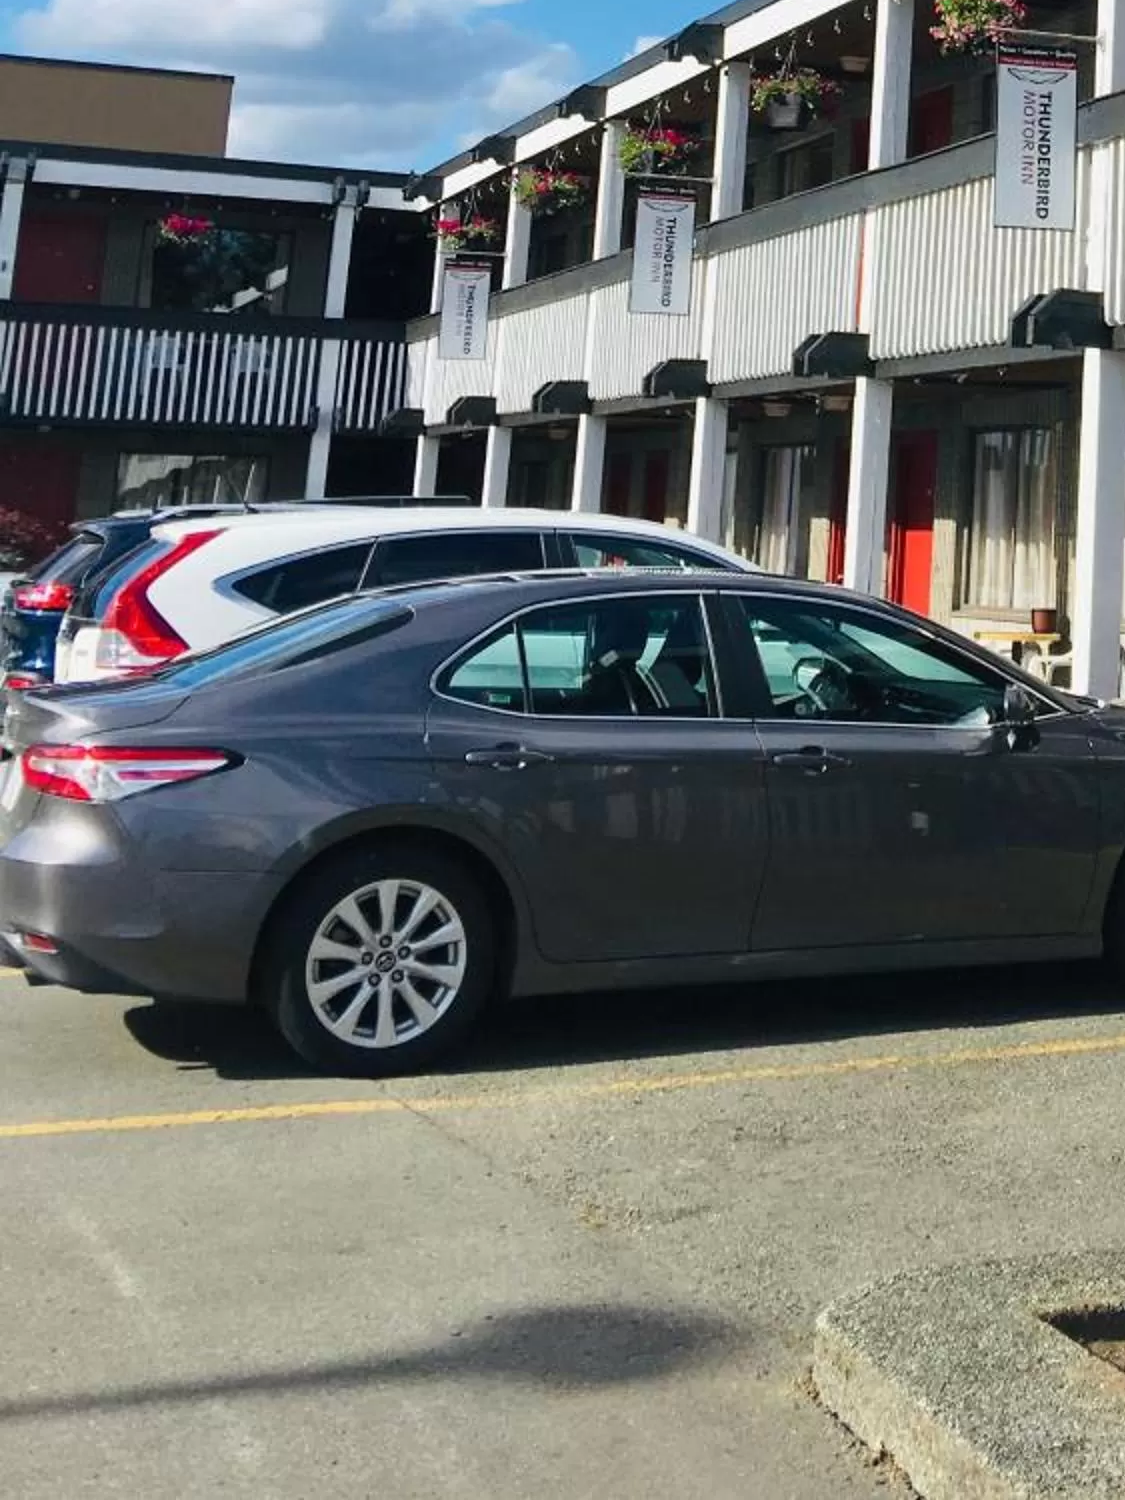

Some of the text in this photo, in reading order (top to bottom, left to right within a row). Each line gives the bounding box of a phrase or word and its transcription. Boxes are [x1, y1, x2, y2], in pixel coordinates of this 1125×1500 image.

[1021, 90, 1036, 185] MOTOR INN
[1036, 91, 1053, 219] THUNDERBIRD
